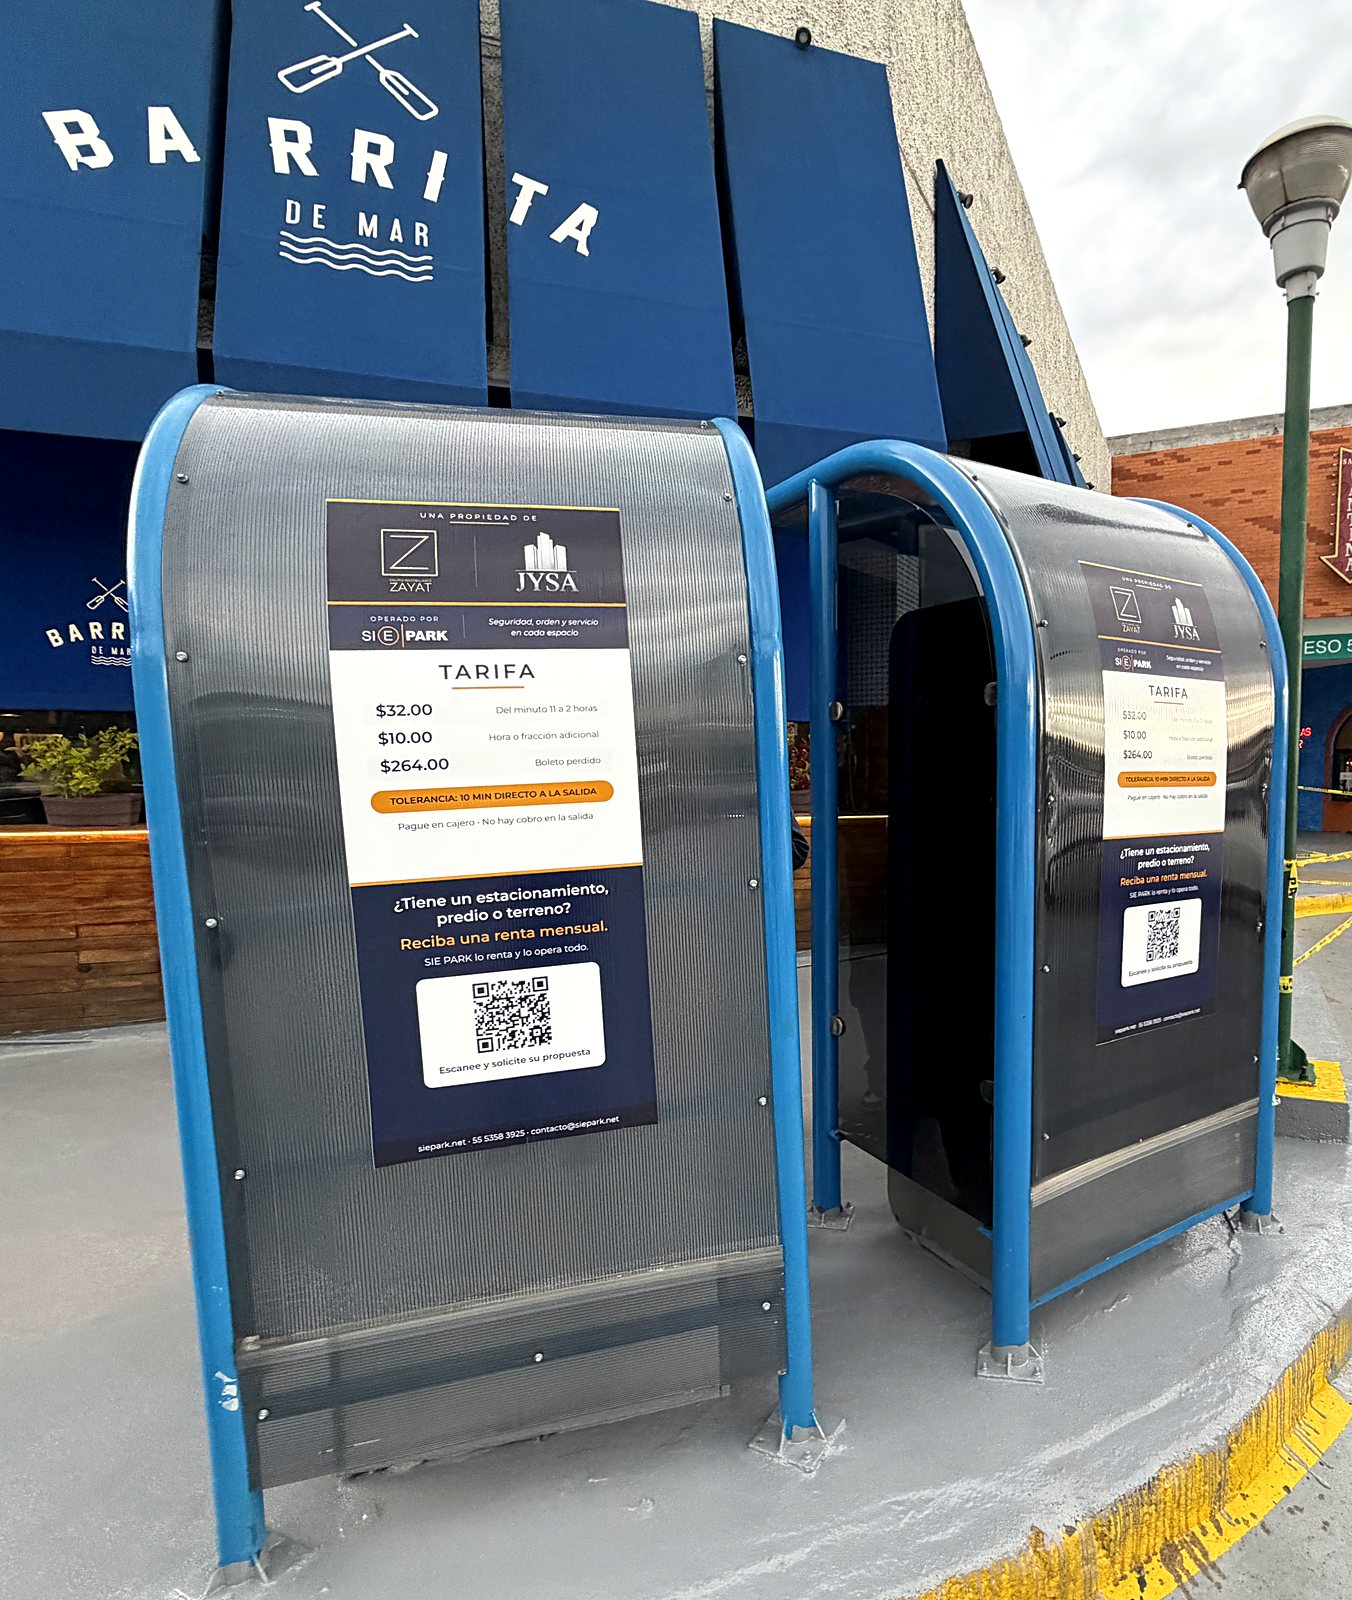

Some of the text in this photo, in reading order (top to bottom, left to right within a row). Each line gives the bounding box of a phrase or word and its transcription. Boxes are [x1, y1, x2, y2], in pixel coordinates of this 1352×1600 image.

[42, 106, 599, 257] BARRITA
[285, 199, 429, 247] DE MAR
[449, 513, 517, 521] PROPIEDAD
[389, 582, 432, 592] ZAYAT
[515, 572, 579, 592] JYSA
[488, 617, 599, 627] Seguridad, orden y servicio
[45, 621, 125, 648] BARR
[405, 630, 449, 642] PARK
[510, 629, 579, 638] en cada espacio
[1173, 624, 1200, 641] JYSA
[91, 646, 104, 654] DE
[1304, 639, 1341, 655] ESO
[438, 664, 535, 680] TARIFA
[1133, 659, 1152, 669] PARK
[1148, 684, 1188, 699] TARIFA
[376, 702, 432, 719] $32.00
[496, 706, 511, 714] Del
[514, 705, 547, 714] minuto
[549, 705, 556, 713] 11
[573, 704, 598, 713] horas
[1122, 710, 1147, 721] $32.00
[378, 731, 432, 746] $10.00
[488, 733, 511, 741] Hora
[521, 731, 557, 740] fracción
[559, 730, 599, 739] adicional
[1123, 729, 1146, 740] $10.00
[1123, 749, 1153, 760] $264.00
[380, 757, 601, 774] $264.00 Boleto perdido
[390, 794, 458, 805] TOLERANCIA:
[460, 793, 470, 801] 10
[472, 792, 492, 800] MIN
[494, 790, 537, 800] DIRECTO
[548, 789, 561, 797] LA
[562, 787, 597, 796] SALIDA
[398, 822, 430, 832] Pague
[431, 821, 444, 829] en
[446, 819, 475, 829] cajero
[482, 818, 495, 826] No
[497, 816, 514, 826] hay
[516, 815, 542, 824] cobro
[558, 813, 566, 821] la
[568, 812, 594, 820] salida
[1120, 842, 1210, 860] ¿Tiene un estacionamiento,
[1137, 855, 1195, 871] predio o terreno?
[1120, 868, 1208, 887] Reciba una renta mensual.
[393, 883, 609, 913] ¿Tiene un estacionamiento,
[436, 902, 571, 928] predio o terreno?
[400, 920, 608, 950] Reciba una renta mensual.
[424, 942, 589, 967] SIE PARK lo renta y lo opera todo.
[439, 1049, 591, 1074] Escanee y solicite su propuesta
[417, 1116, 619, 1152] siepark.net 55 5358 3925 contacto@siepark.net
